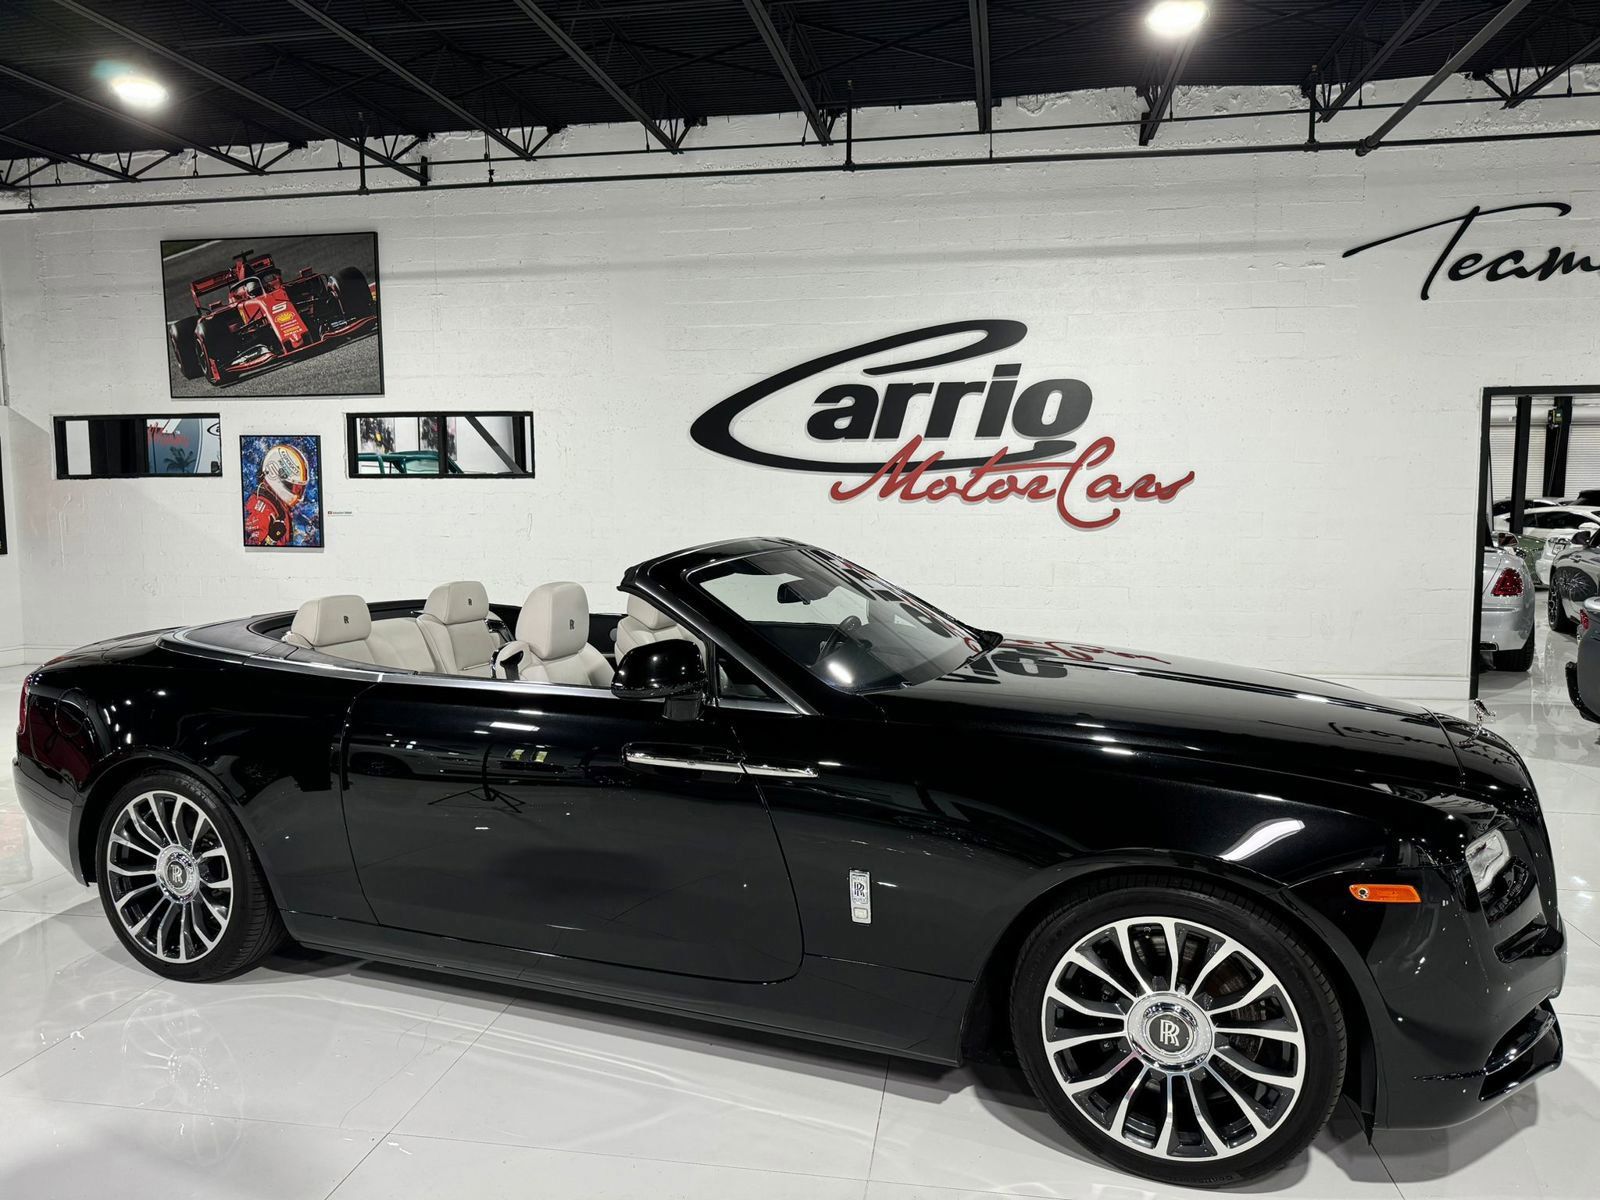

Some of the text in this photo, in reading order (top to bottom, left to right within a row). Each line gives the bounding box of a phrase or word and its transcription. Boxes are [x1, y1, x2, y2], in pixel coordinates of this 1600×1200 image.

[1342, 202, 1600, 301] Team
[690, 319, 1092, 474] Carrio
[1160, 1019, 1180, 1047] RR
